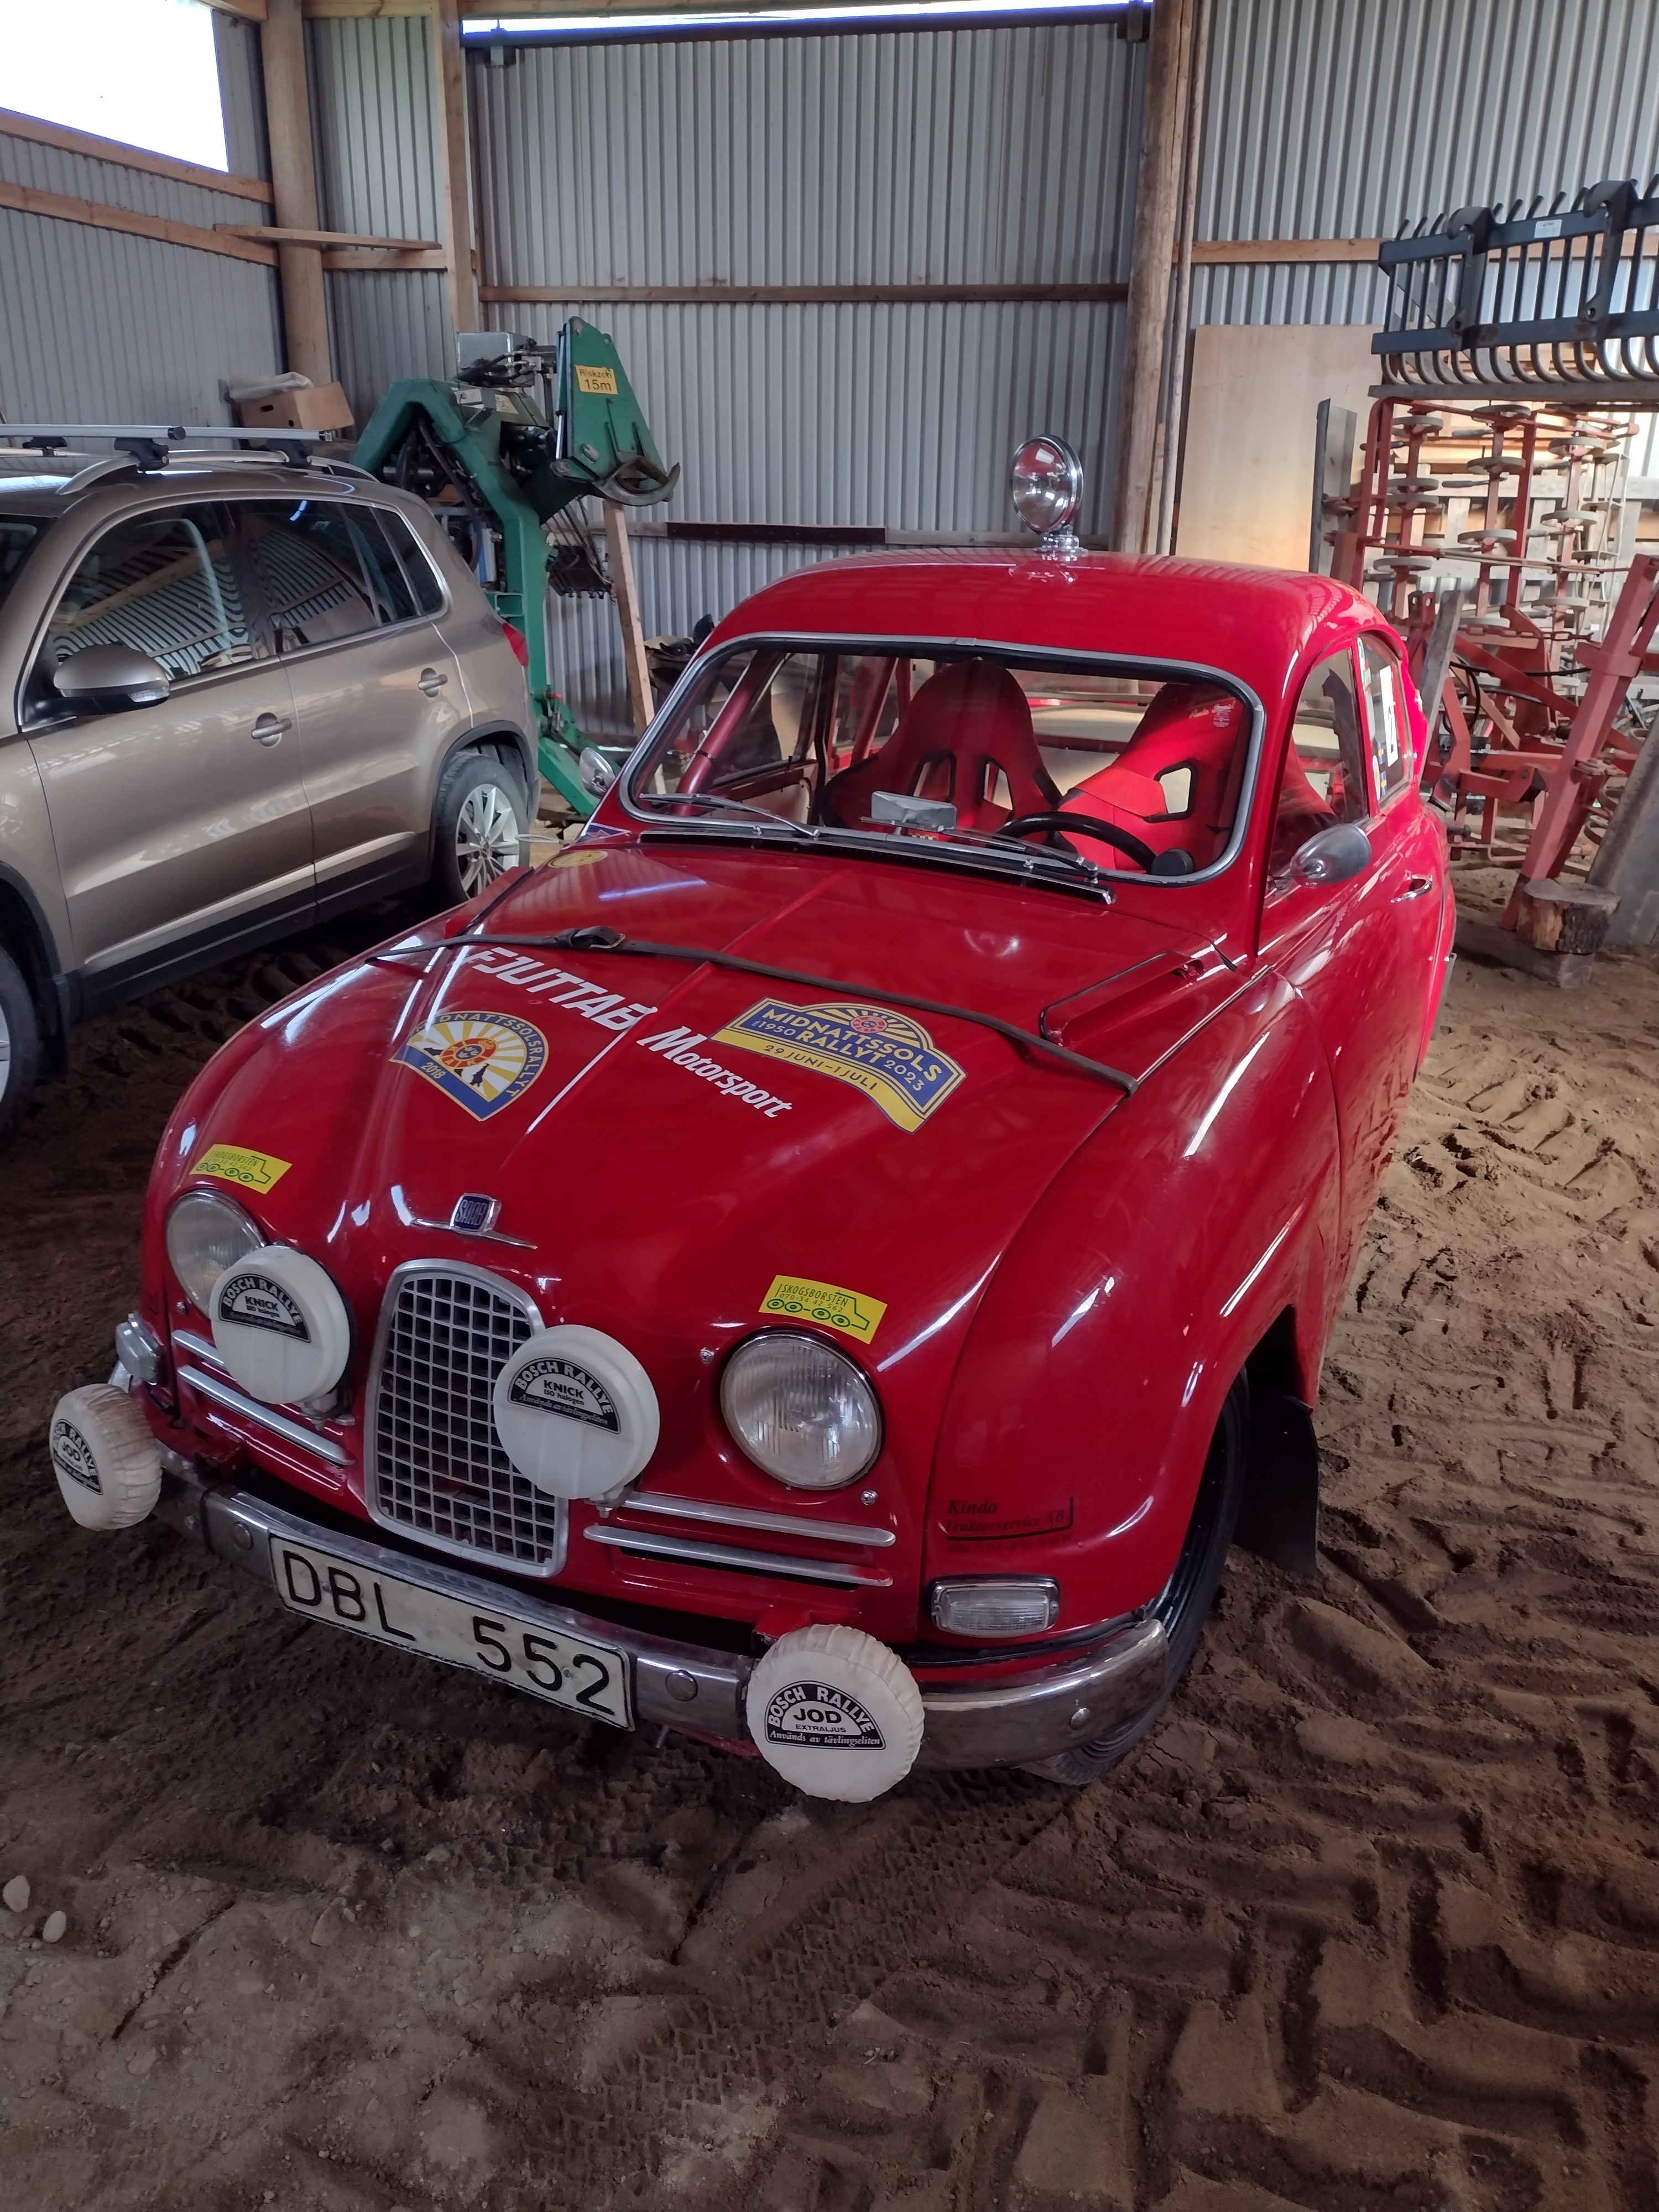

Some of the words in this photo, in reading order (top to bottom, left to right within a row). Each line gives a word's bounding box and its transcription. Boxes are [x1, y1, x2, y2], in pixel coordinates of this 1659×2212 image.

[585, 379, 612, 391] 15m
[758, 1021, 796, 1036] 1950
[795, 1030, 886, 1063] RALLYT
[883, 1060, 925, 1091] 2023
[762, 1009, 942, 1082] MIDNATTSSOLS
[420, 1061, 446, 1079] 2018
[636, 1026, 792, 1118] Motorsport
[763, 1045, 785, 1054] 29
[839, 1070, 878, 1091] JULI
[455, 1199, 488, 1225] SAAB
[222, 1277, 256, 1307] BOSCH
[258, 1279, 301, 1324] RALLYE
[244, 1295, 280, 1312] KNICK
[779, 1292, 809, 1303] 070-34
[826, 1303, 843, 1313] 562
[782, 1284, 849, 1307] SKOGSBORSTEN
[514, 1361, 559, 1390] BOSCH
[564, 1364, 614, 1414] RALLYE
[544, 1379, 585, 1400] KNICK
[557, 1392, 585, 1406] halogen
[947, 1498, 998, 1514] Kinda
[283, 1550, 416, 1641] DBL
[471, 1615, 615, 1716] 552
[768, 1686, 807, 1728] BOSCH
[816, 1686, 875, 1733] RALLYE
[793, 1708, 842, 1724] JOD
[769, 1730, 806, 1742] Används
[824, 1735, 881, 1747] tävlingseliten
[795, 1724, 847, 1733] EXTRALJUS
